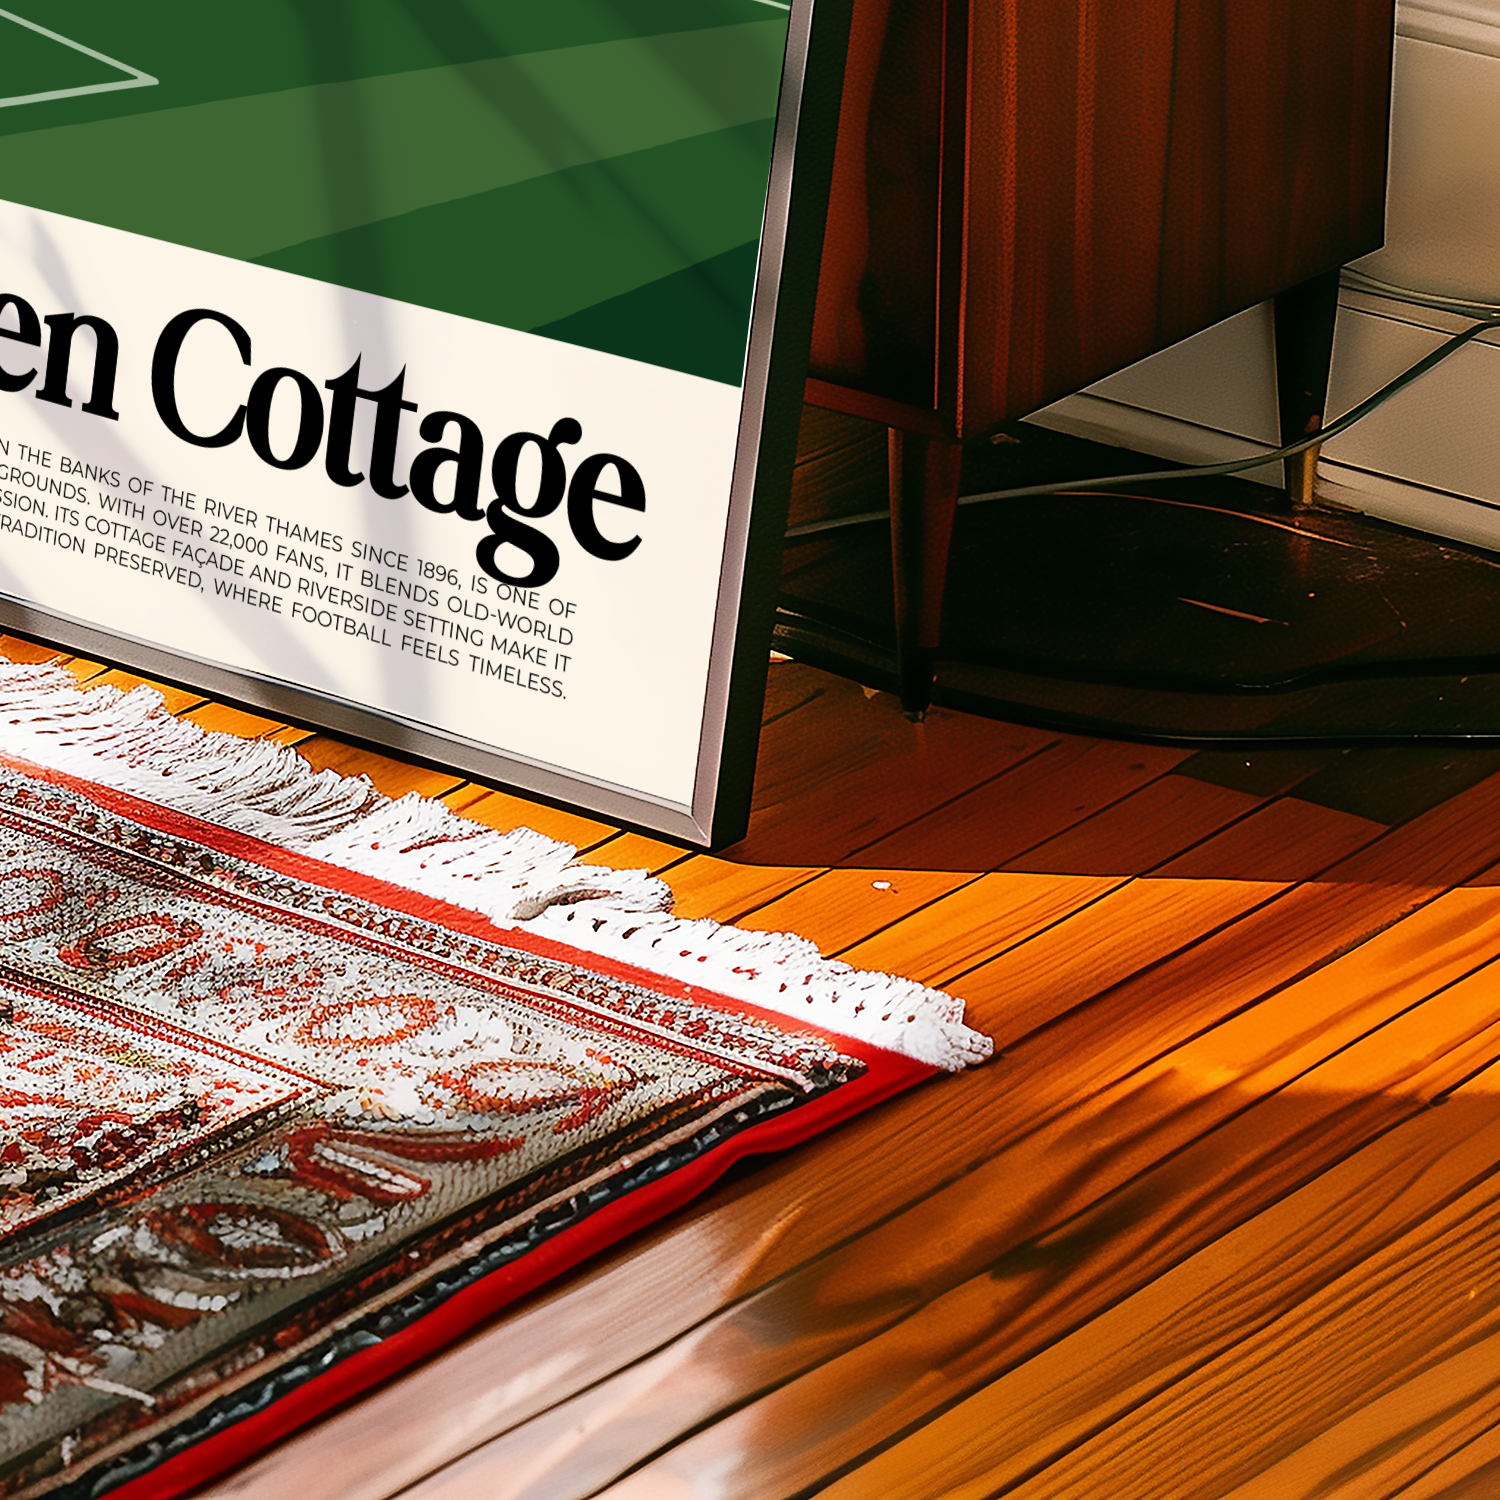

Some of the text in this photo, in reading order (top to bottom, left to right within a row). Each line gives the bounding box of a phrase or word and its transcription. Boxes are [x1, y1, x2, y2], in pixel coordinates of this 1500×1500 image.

[18, 444, 52, 468] THE
[60, 456, 120, 488] BANKS
[128, 477, 154, 496] OF
[161, 485, 196, 510] THE
[205, 498, 257, 528] RIVER
[266, 515, 343, 552] THAMES
[351, 541, 408, 572] SINCE
[417, 559, 461, 590] 1896,
[471, 575, 488, 594] IS
[496, 583, 540, 610] ONE
[549, 598, 577, 619] OF
[152, 309, 645, 589] Cottage
[55, 505, 79, 526] ITS
[85, 515, 166, 553] COTTAGE
[172, 540, 245, 577] FAÇADE
[249, 564, 291, 589] AND
[298, 577, 397, 622] RIVERSIDE
[403, 609, 483, 647] SETTING
[491, 634, 547, 667] MAKE
[555, 653, 572, 672] IT
[94, 542, 204, 593] PRESERVED,
[214, 578, 283, 614] WHERE
[292, 602, 391, 647] FOOTBALL
[401, 634, 459, 666] FEELS
[469, 654, 566, 700] TIMELESS.
[99, 492, 145, 521] WITH
[153, 510, 203, 538] OVER
[209, 526, 268, 556] 22,000
[276, 545, 327, 578] FANS,
[337, 562, 354, 581] IT
[361, 569, 439, 607] BLENDS
[447, 596, 573, 645] OLD-WORLD
